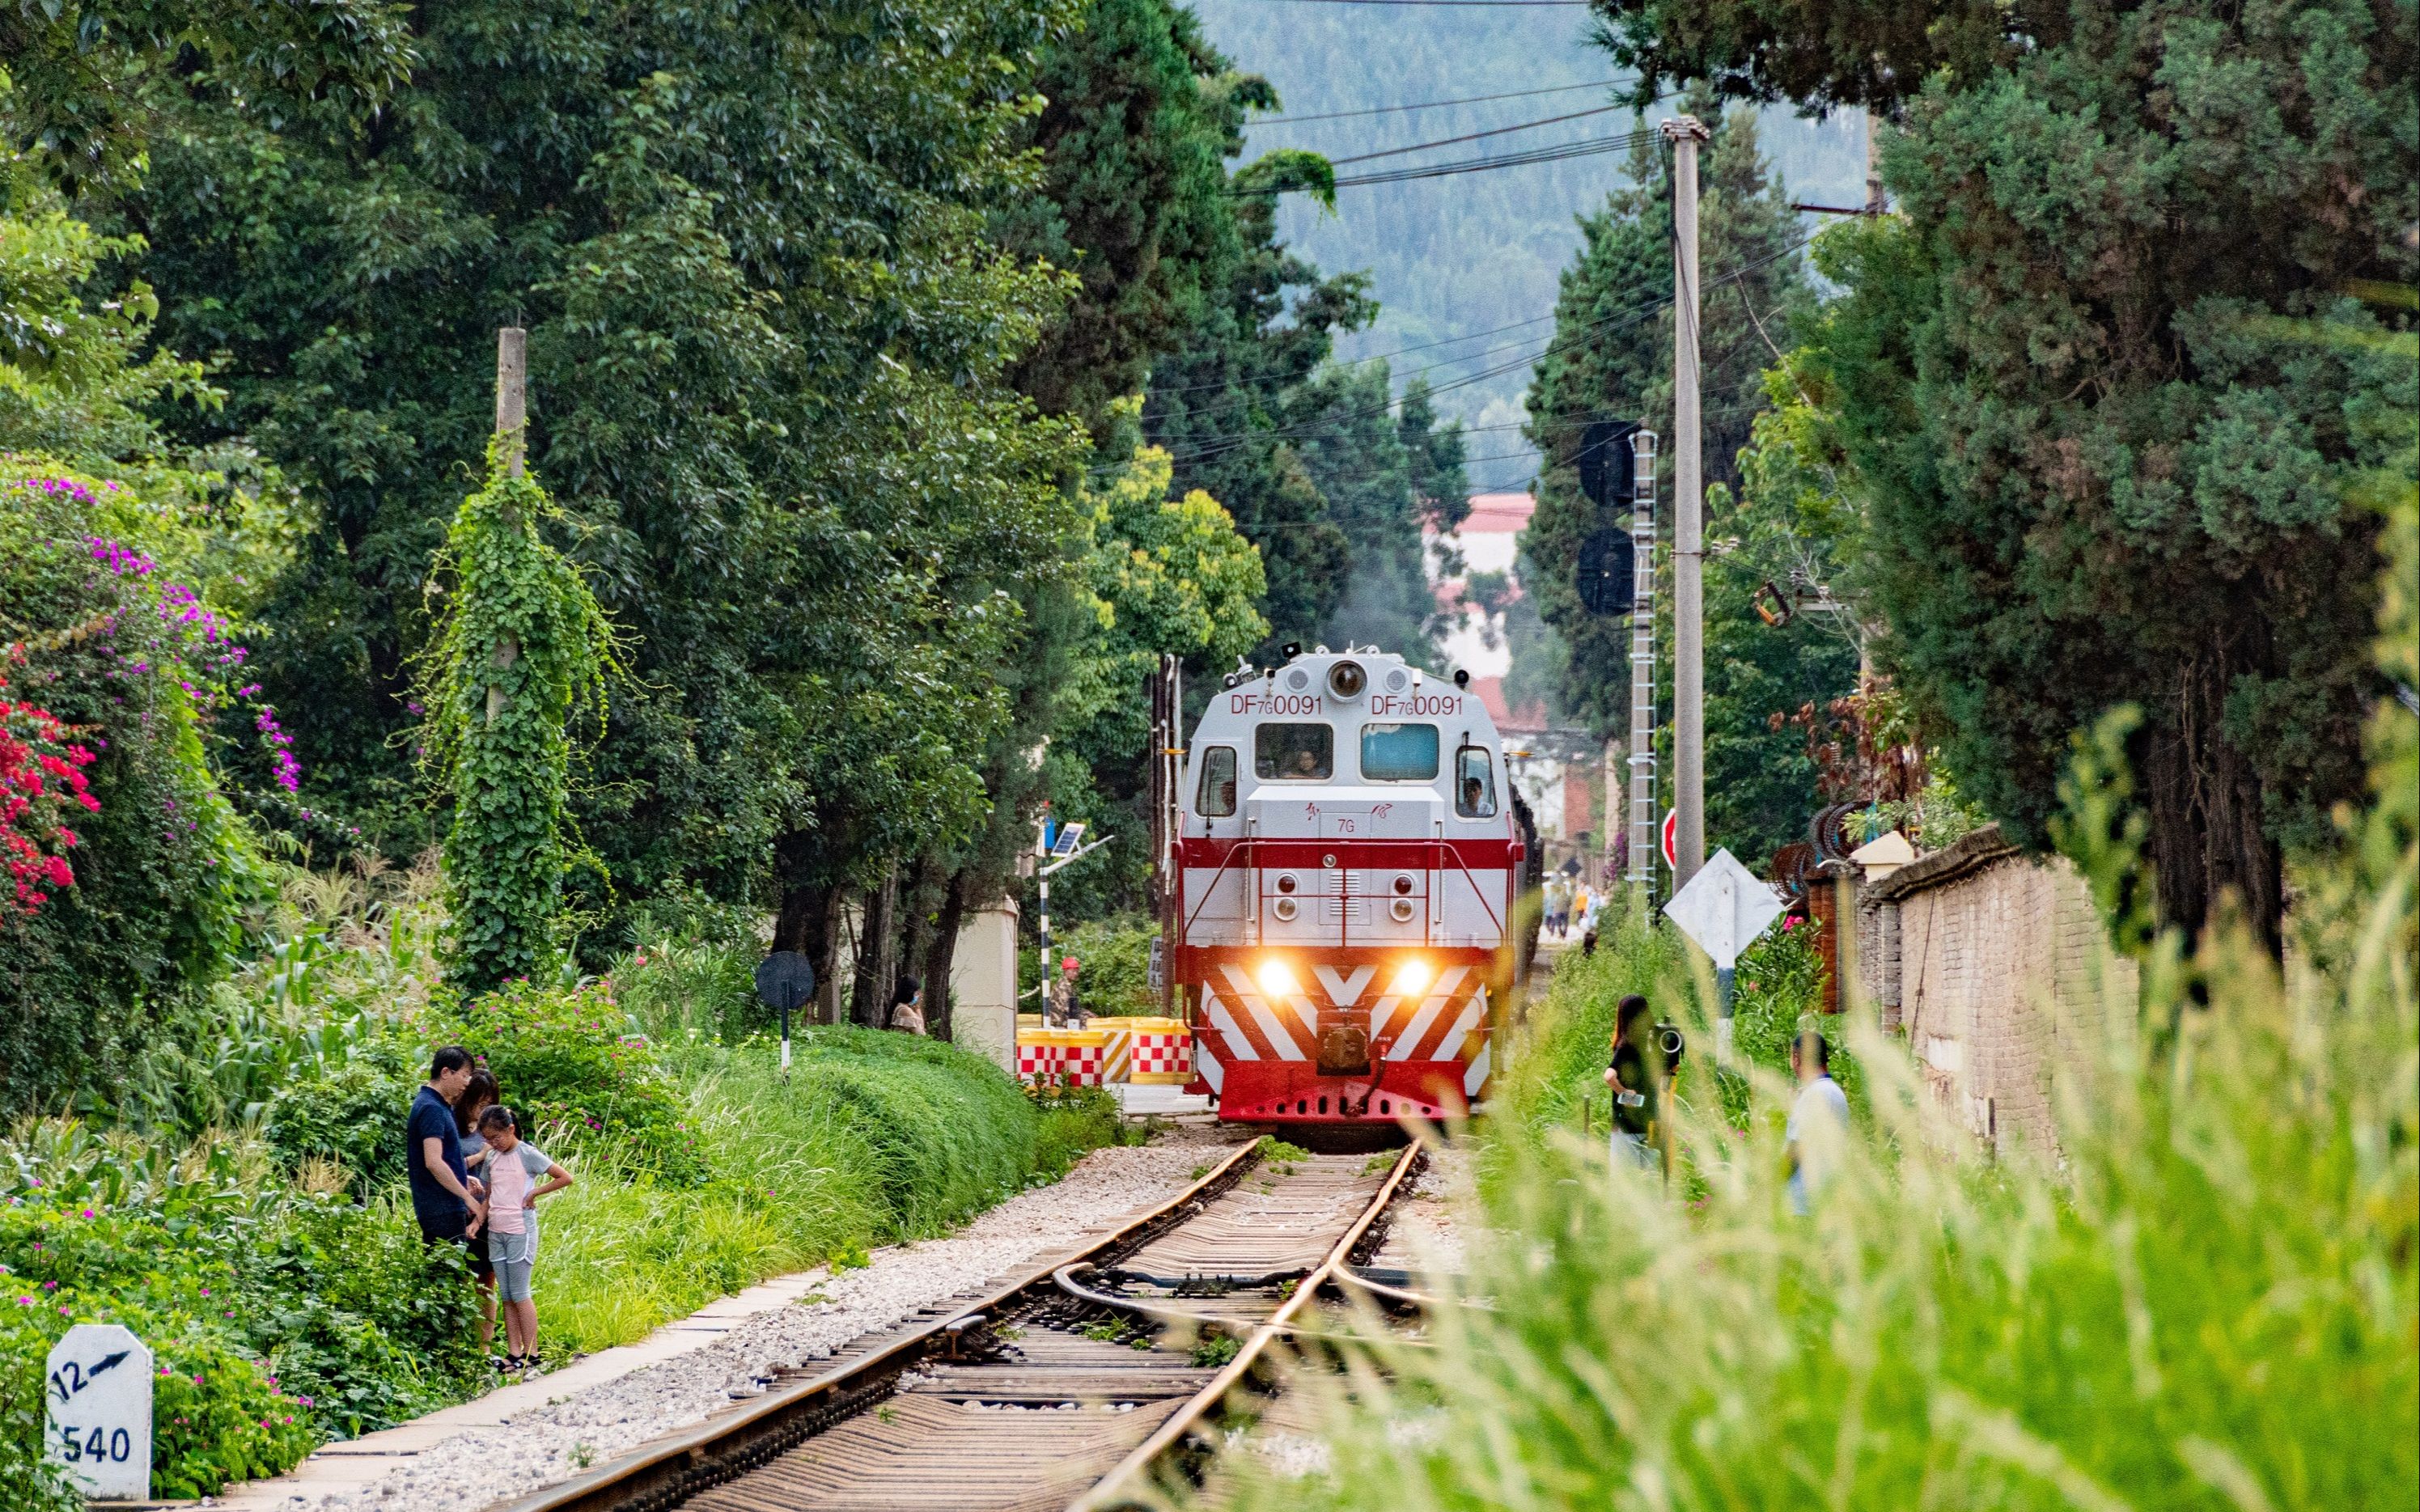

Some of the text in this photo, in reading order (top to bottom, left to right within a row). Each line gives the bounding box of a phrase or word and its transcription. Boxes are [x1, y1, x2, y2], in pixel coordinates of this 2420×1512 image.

[1231, 694, 1322, 715] DF7G0091
[1371, 695, 1463, 716] DF7G0091
[1337, 819, 1355, 832] 7G
[51, 1361, 89, 1401] 12
[63, 1426, 130, 1463] 540
